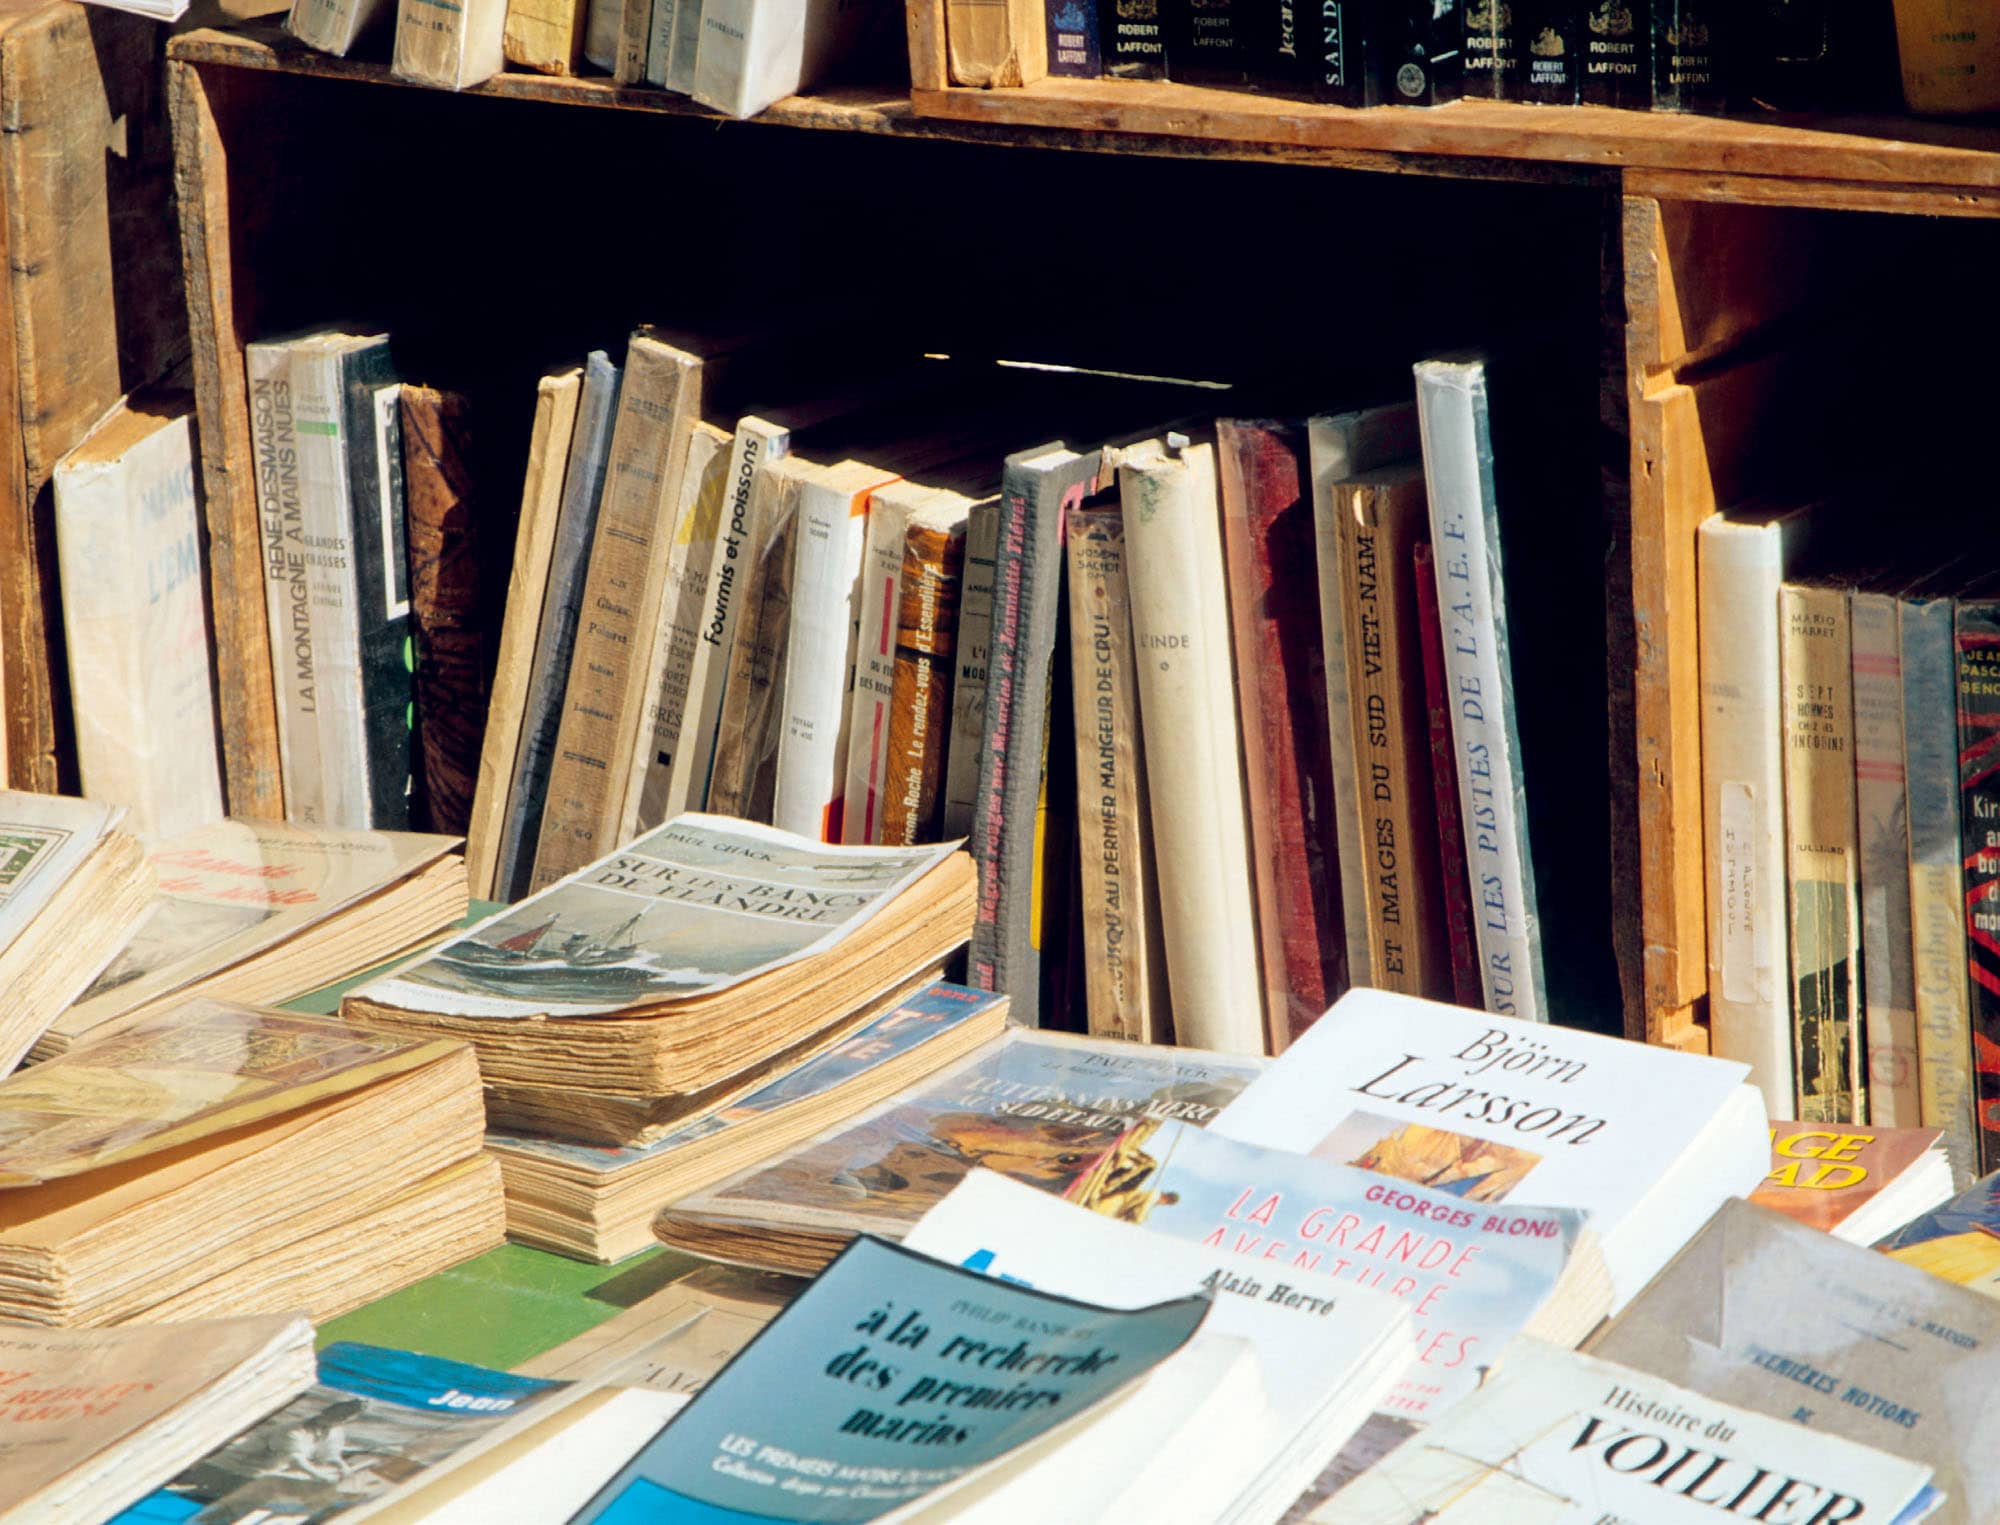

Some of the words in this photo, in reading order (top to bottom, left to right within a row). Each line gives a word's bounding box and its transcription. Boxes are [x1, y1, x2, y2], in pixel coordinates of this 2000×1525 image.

[1118, 24, 1160, 36] ROBERT
[1193, 17, 1230, 27] ROBERT
[1057, 34, 1085, 49] ROBERT
[1057, 50, 1087, 64] LAFFONT
[1117, 42, 1163, 54] LAFFONT
[1193, 38, 1234, 48] LAFFONT
[1466, 37, 1513, 49] ROBERT
[1589, 41, 1635, 54] ROBERT
[1465, 57, 1517, 70] LAFFONT
[1530, 73, 1566, 84] LAFFONT
[1532, 61, 1564, 72] ROBERT
[1588, 62, 1637, 74] LAFFONT
[1669, 72, 1711, 84] LAFFONT
[1671, 55, 1708, 67] ROBERT
[273, 379, 295, 442] NUES
[279, 449, 302, 523] MAINS
[731, 438, 759, 537] poissons
[285, 525, 304, 544] A
[723, 534, 740, 560] et
[967, 584, 993, 594] ANDR
[1000, 558, 1023, 649] Jeannette
[1356, 534, 1383, 679] VIET-NAM
[287, 552, 315, 681] MONTAGNE
[1791, 614, 1836, 627] MARIO
[1140, 634, 1190, 649] L'INDE
[1001, 652, 1016, 672] et
[1096, 667, 1114, 692] DE
[300, 686, 316, 713] LA
[912, 657, 931, 736] rendez-vous
[1460, 677, 1485, 725] DE
[1796, 685, 1834, 701] SEPT
[1960, 682, 2000, 696] BENO
[992, 677, 1013, 751] Maurice
[1367, 694, 1388, 748] SUD
[1797, 703, 1835, 720] HOMMES
[914, 739, 925, 759] Le
[1098, 697, 1118, 791] MANGEUR
[991, 755, 1007, 792] par
[1371, 763, 1392, 802] DU
[903, 766, 923, 846] rison-Roche
[1466, 741, 1499, 856] PISTES
[1973, 795, 2000, 820] Kir
[985, 793, 1004, 856] rouges
[1102, 794, 1121, 878] DERNIER
[664, 832, 704, 847] PAUL
[712, 840, 775, 863] CHACK
[613, 857, 679, 882] SUR
[688, 877, 741, 895] LES
[746, 882, 876, 908] BANCS
[1376, 817, 1401, 926] IMAGES
[597, 872, 637, 891] DE
[658, 884, 837, 923] FLANDRE
[1480, 873, 1508, 935] LES
[1385, 939, 1405, 976] ET
[1493, 951, 1517, 1016] SUR
[1449, 1028, 1589, 1083] Björn
[1137, 1097, 1222, 1122] MERC
[1348, 1053, 1607, 1145] Larsson
[1769, 1128, 1876, 1161] GE
[1766, 1161, 1869, 1191] AD
[1363, 1183, 1477, 1229] GEORGES
[1481, 1214, 1562, 1240] BLOND
[1225, 1186, 1281, 1228] LA
[1298, 1206, 1482, 1280] GRANDE
[1199, 1267, 1264, 1298] Alain
[1264, 1281, 1337, 1318] Hervé
[856, 1300, 894, 1338] à
[888, 1308, 930, 1349] la
[938, 1334, 1121, 1377] recherche
[825, 1344, 900, 1391] des
[896, 1375, 1064, 1413] premiers
[427, 1390, 518, 1412] Jean
[1601, 1384, 1703, 1433] Histoire
[1703, 1416, 1738, 1444] du
[1840, 1383, 1922, 1430] NOTIONS
[839, 1407, 979, 1447] marins
[718, 1433, 757, 1459] LES
[1567, 1415, 1867, 1525] VOILIER
